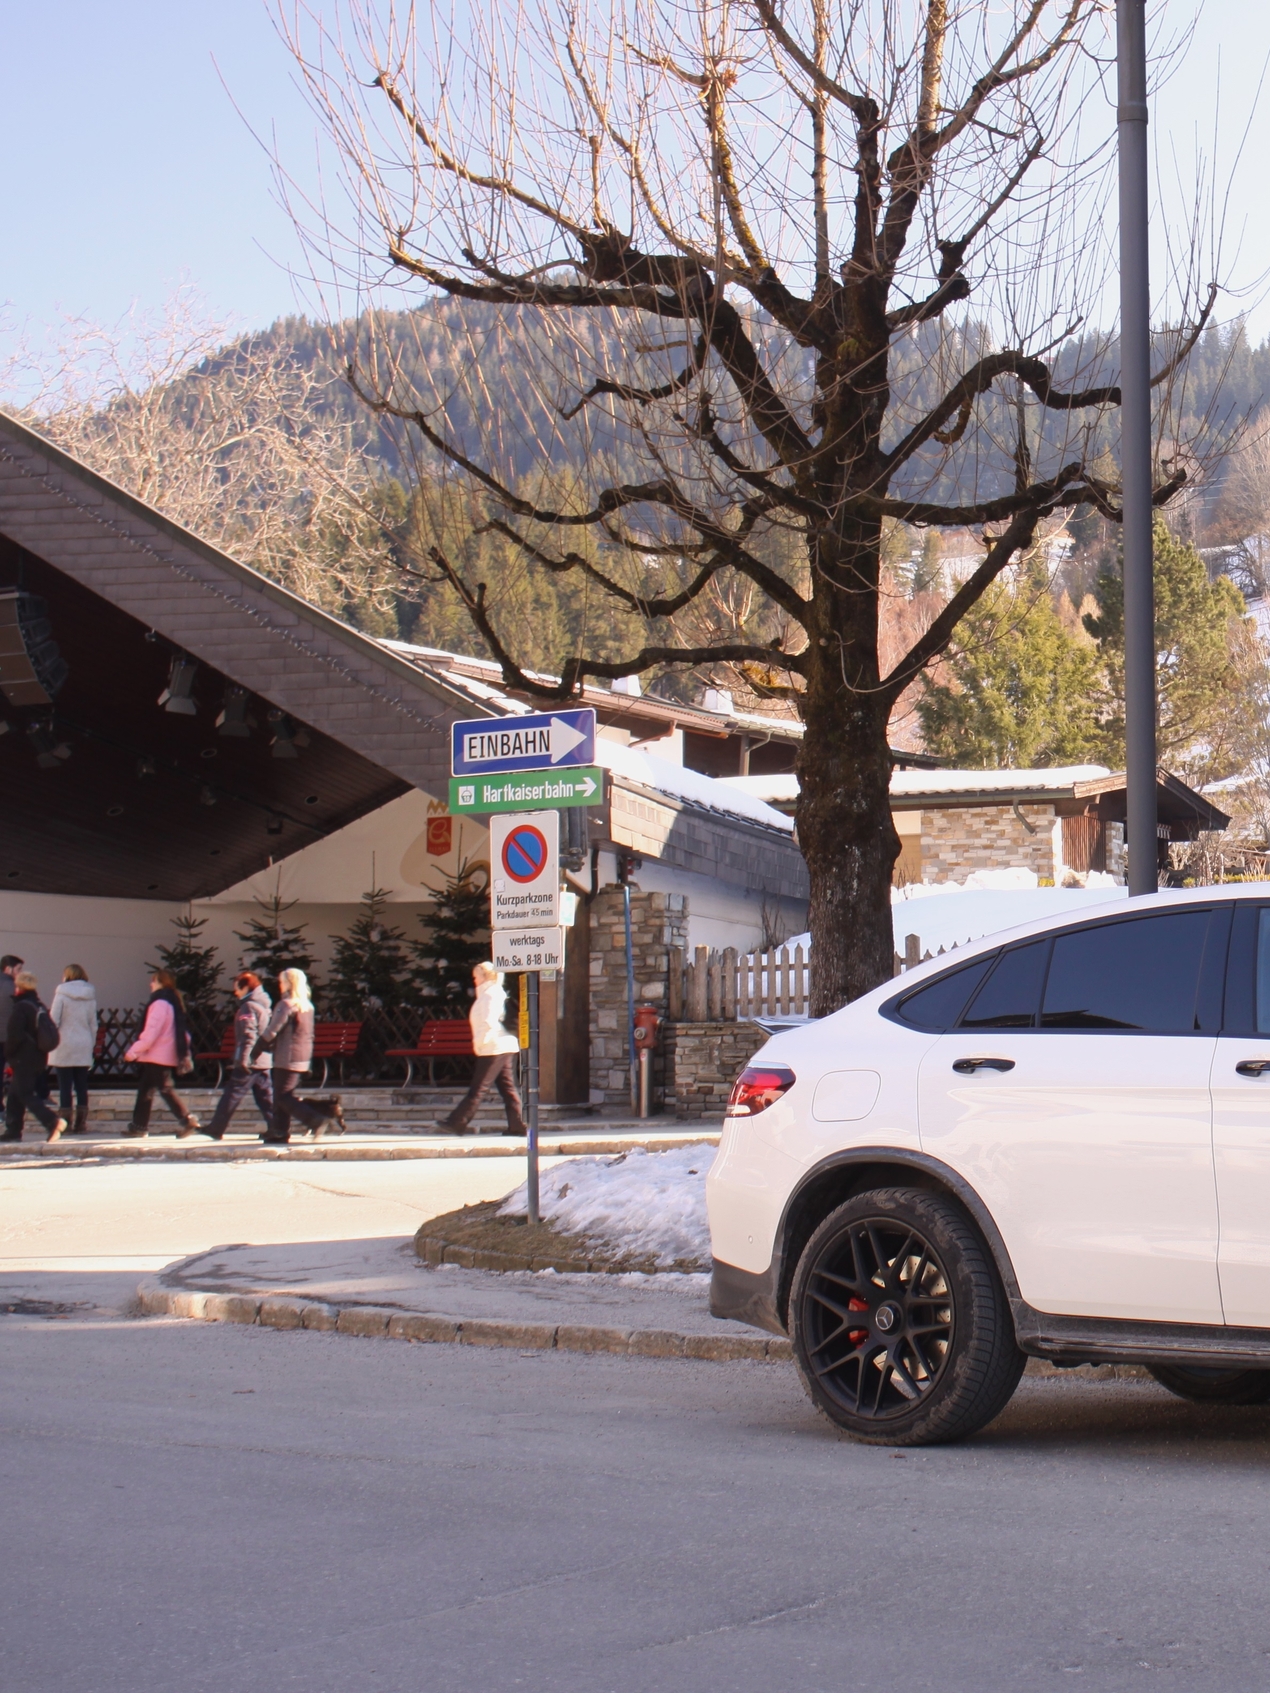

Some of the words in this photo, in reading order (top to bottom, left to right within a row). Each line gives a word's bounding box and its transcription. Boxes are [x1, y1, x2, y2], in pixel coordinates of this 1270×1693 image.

[467, 730, 551, 760] EINBAHN
[496, 892, 553, 907] Kurzparkzone
[496, 909, 530, 920] Parkdauer
[530, 908, 540, 917] 45
[540, 907, 554, 917] min
[509, 934, 545, 947] werktags
[526, 953, 542, 966] 8-18
[544, 952, 559, 965] Uhr
